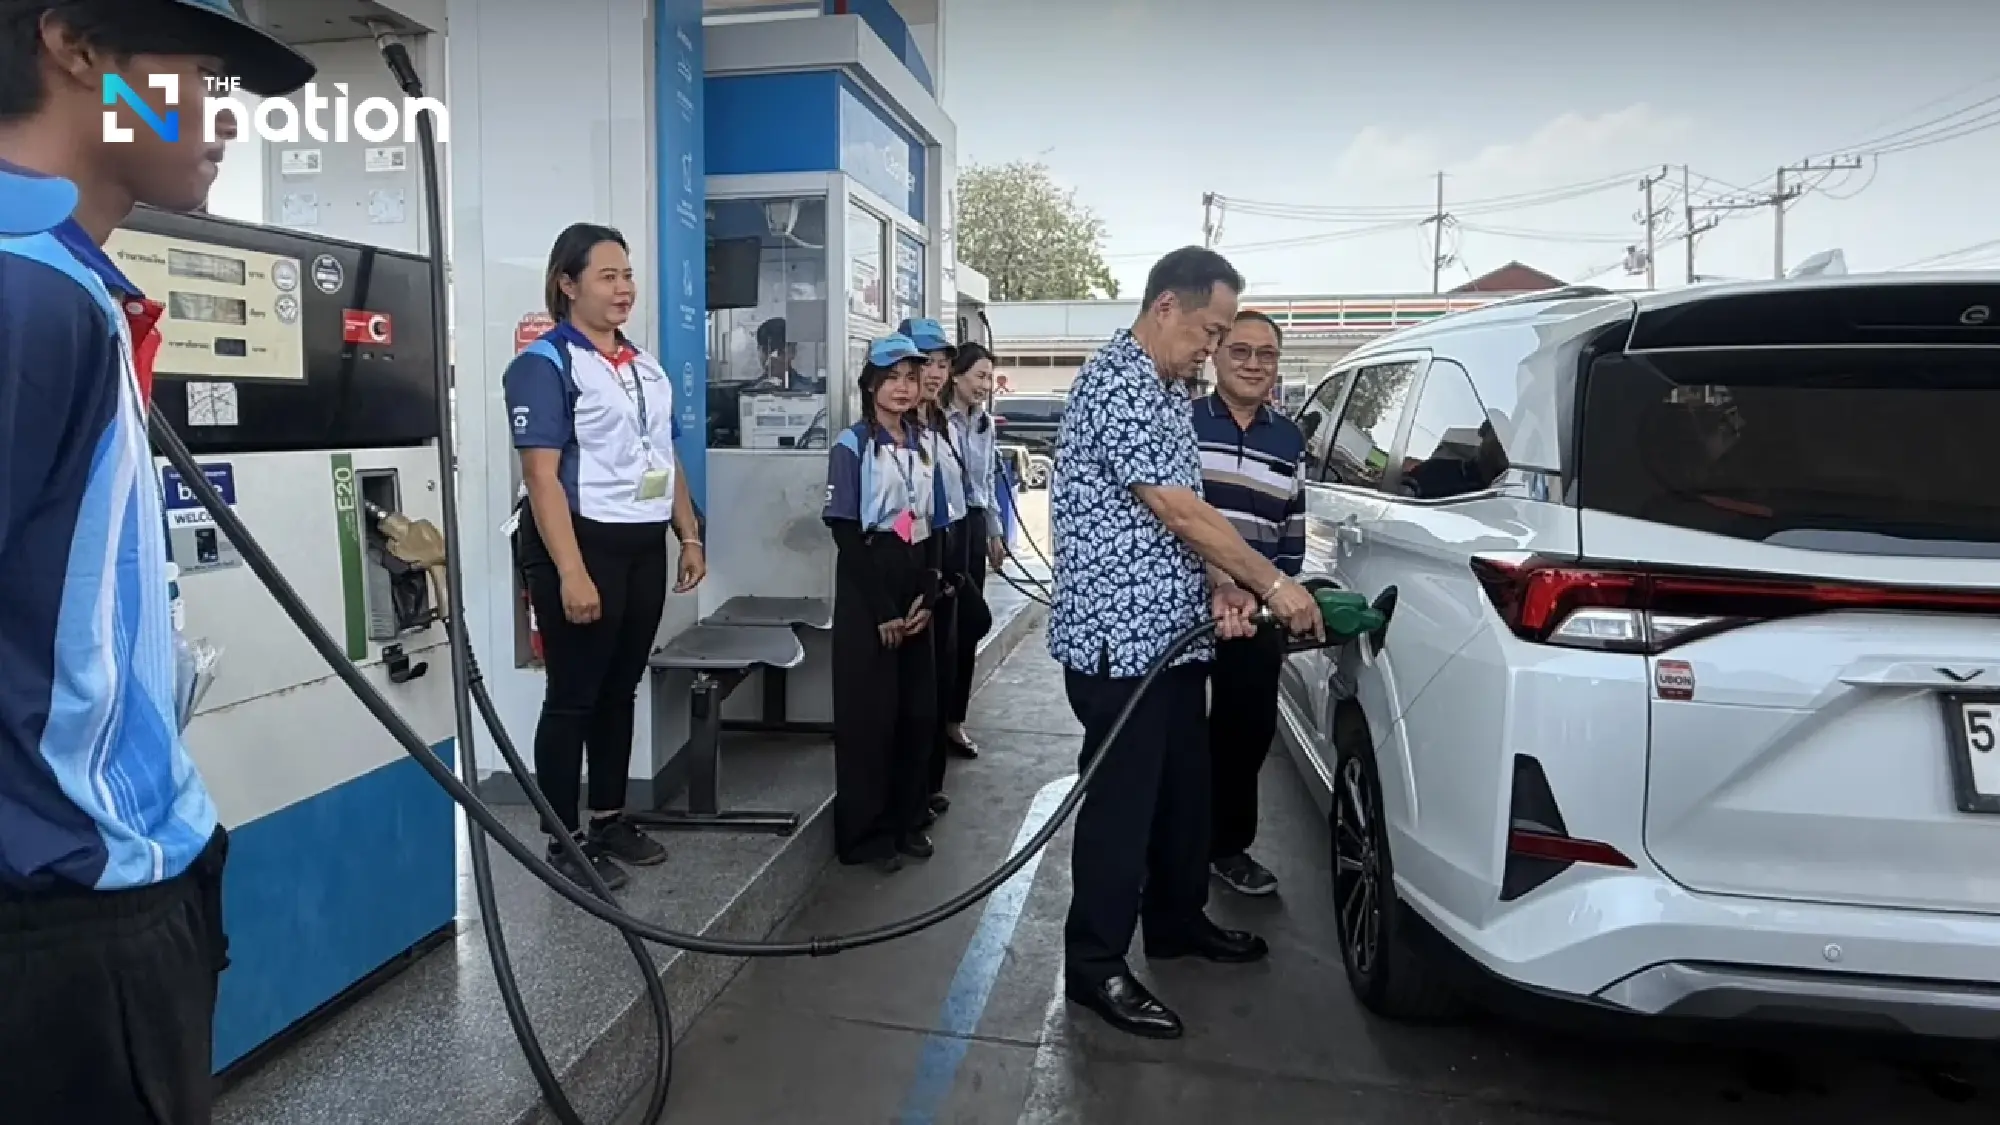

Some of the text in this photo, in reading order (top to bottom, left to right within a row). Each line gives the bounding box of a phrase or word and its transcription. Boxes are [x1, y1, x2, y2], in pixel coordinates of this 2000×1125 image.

[334, 467, 355, 511] E20
[174, 510, 214, 524] WELCO
[1967, 710, 2000, 754] 5
